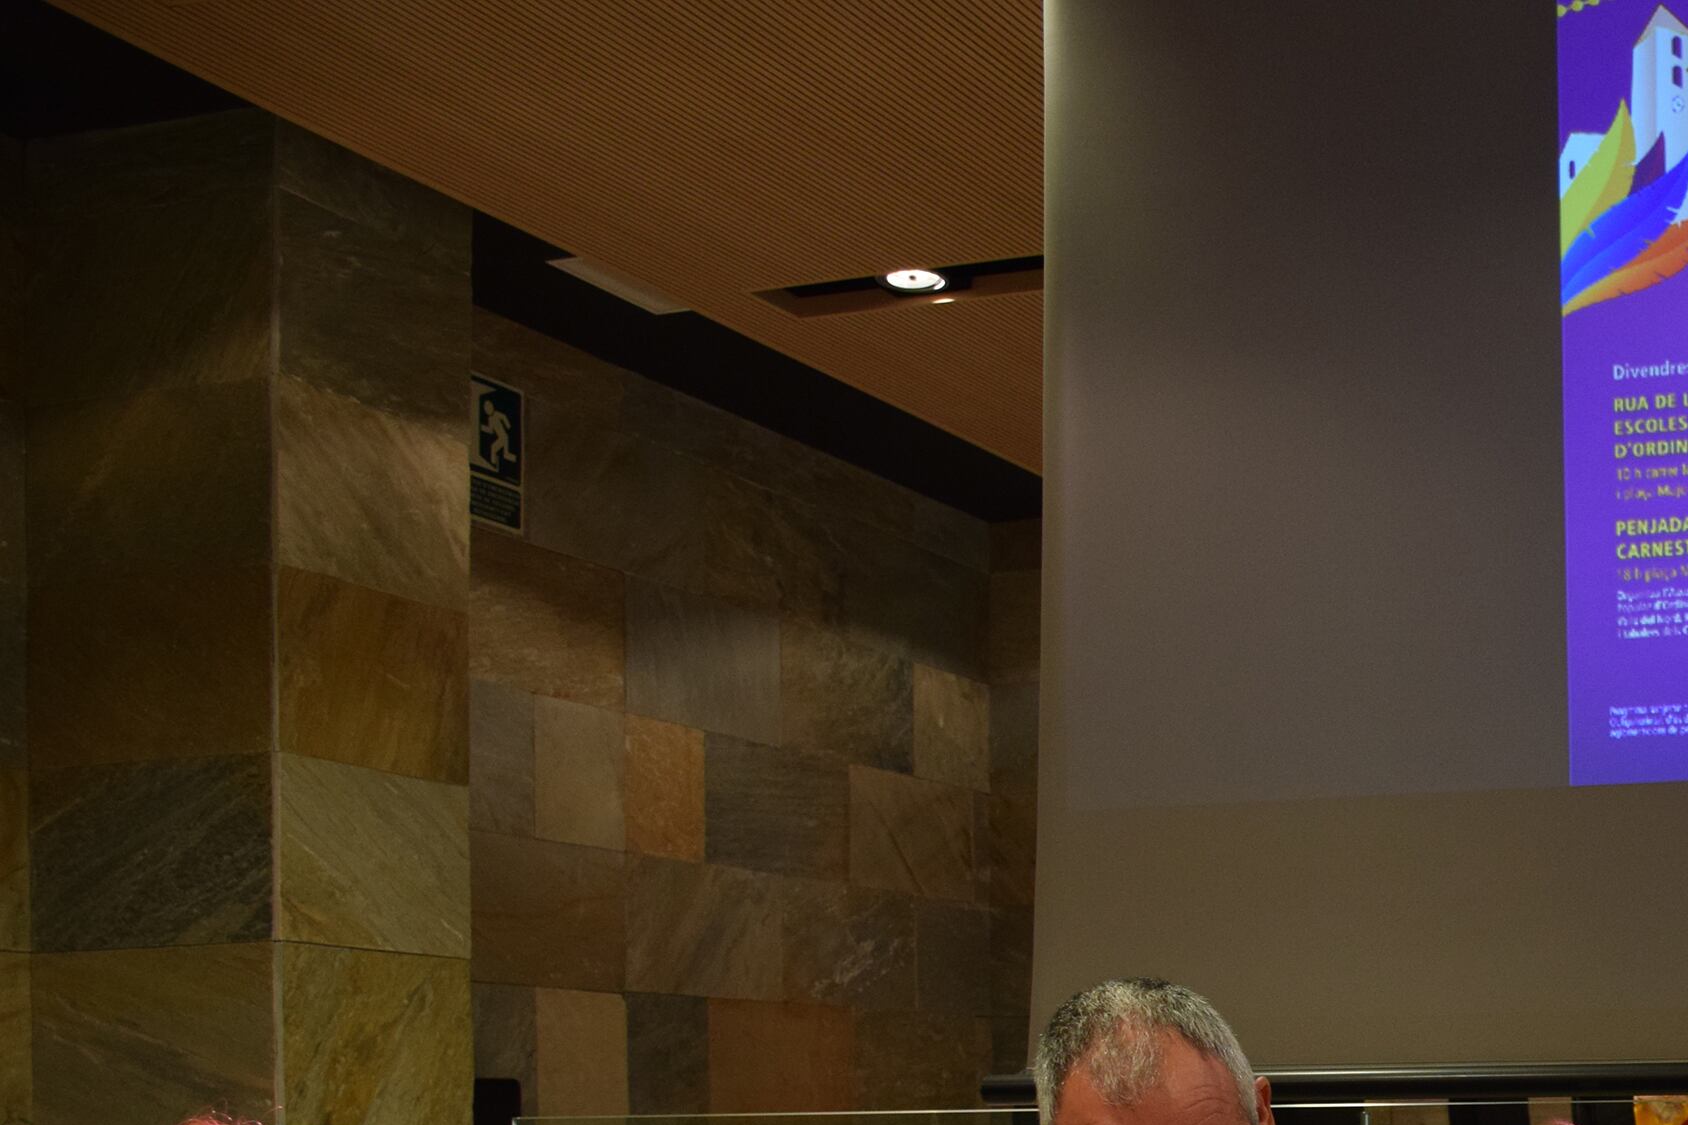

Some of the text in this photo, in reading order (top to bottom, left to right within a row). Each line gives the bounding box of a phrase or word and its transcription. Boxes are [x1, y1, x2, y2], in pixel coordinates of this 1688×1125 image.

[1614, 396, 1648, 412] RUA
[1655, 394, 1677, 409] DE
[1614, 417, 1688, 436] ESCOLES
